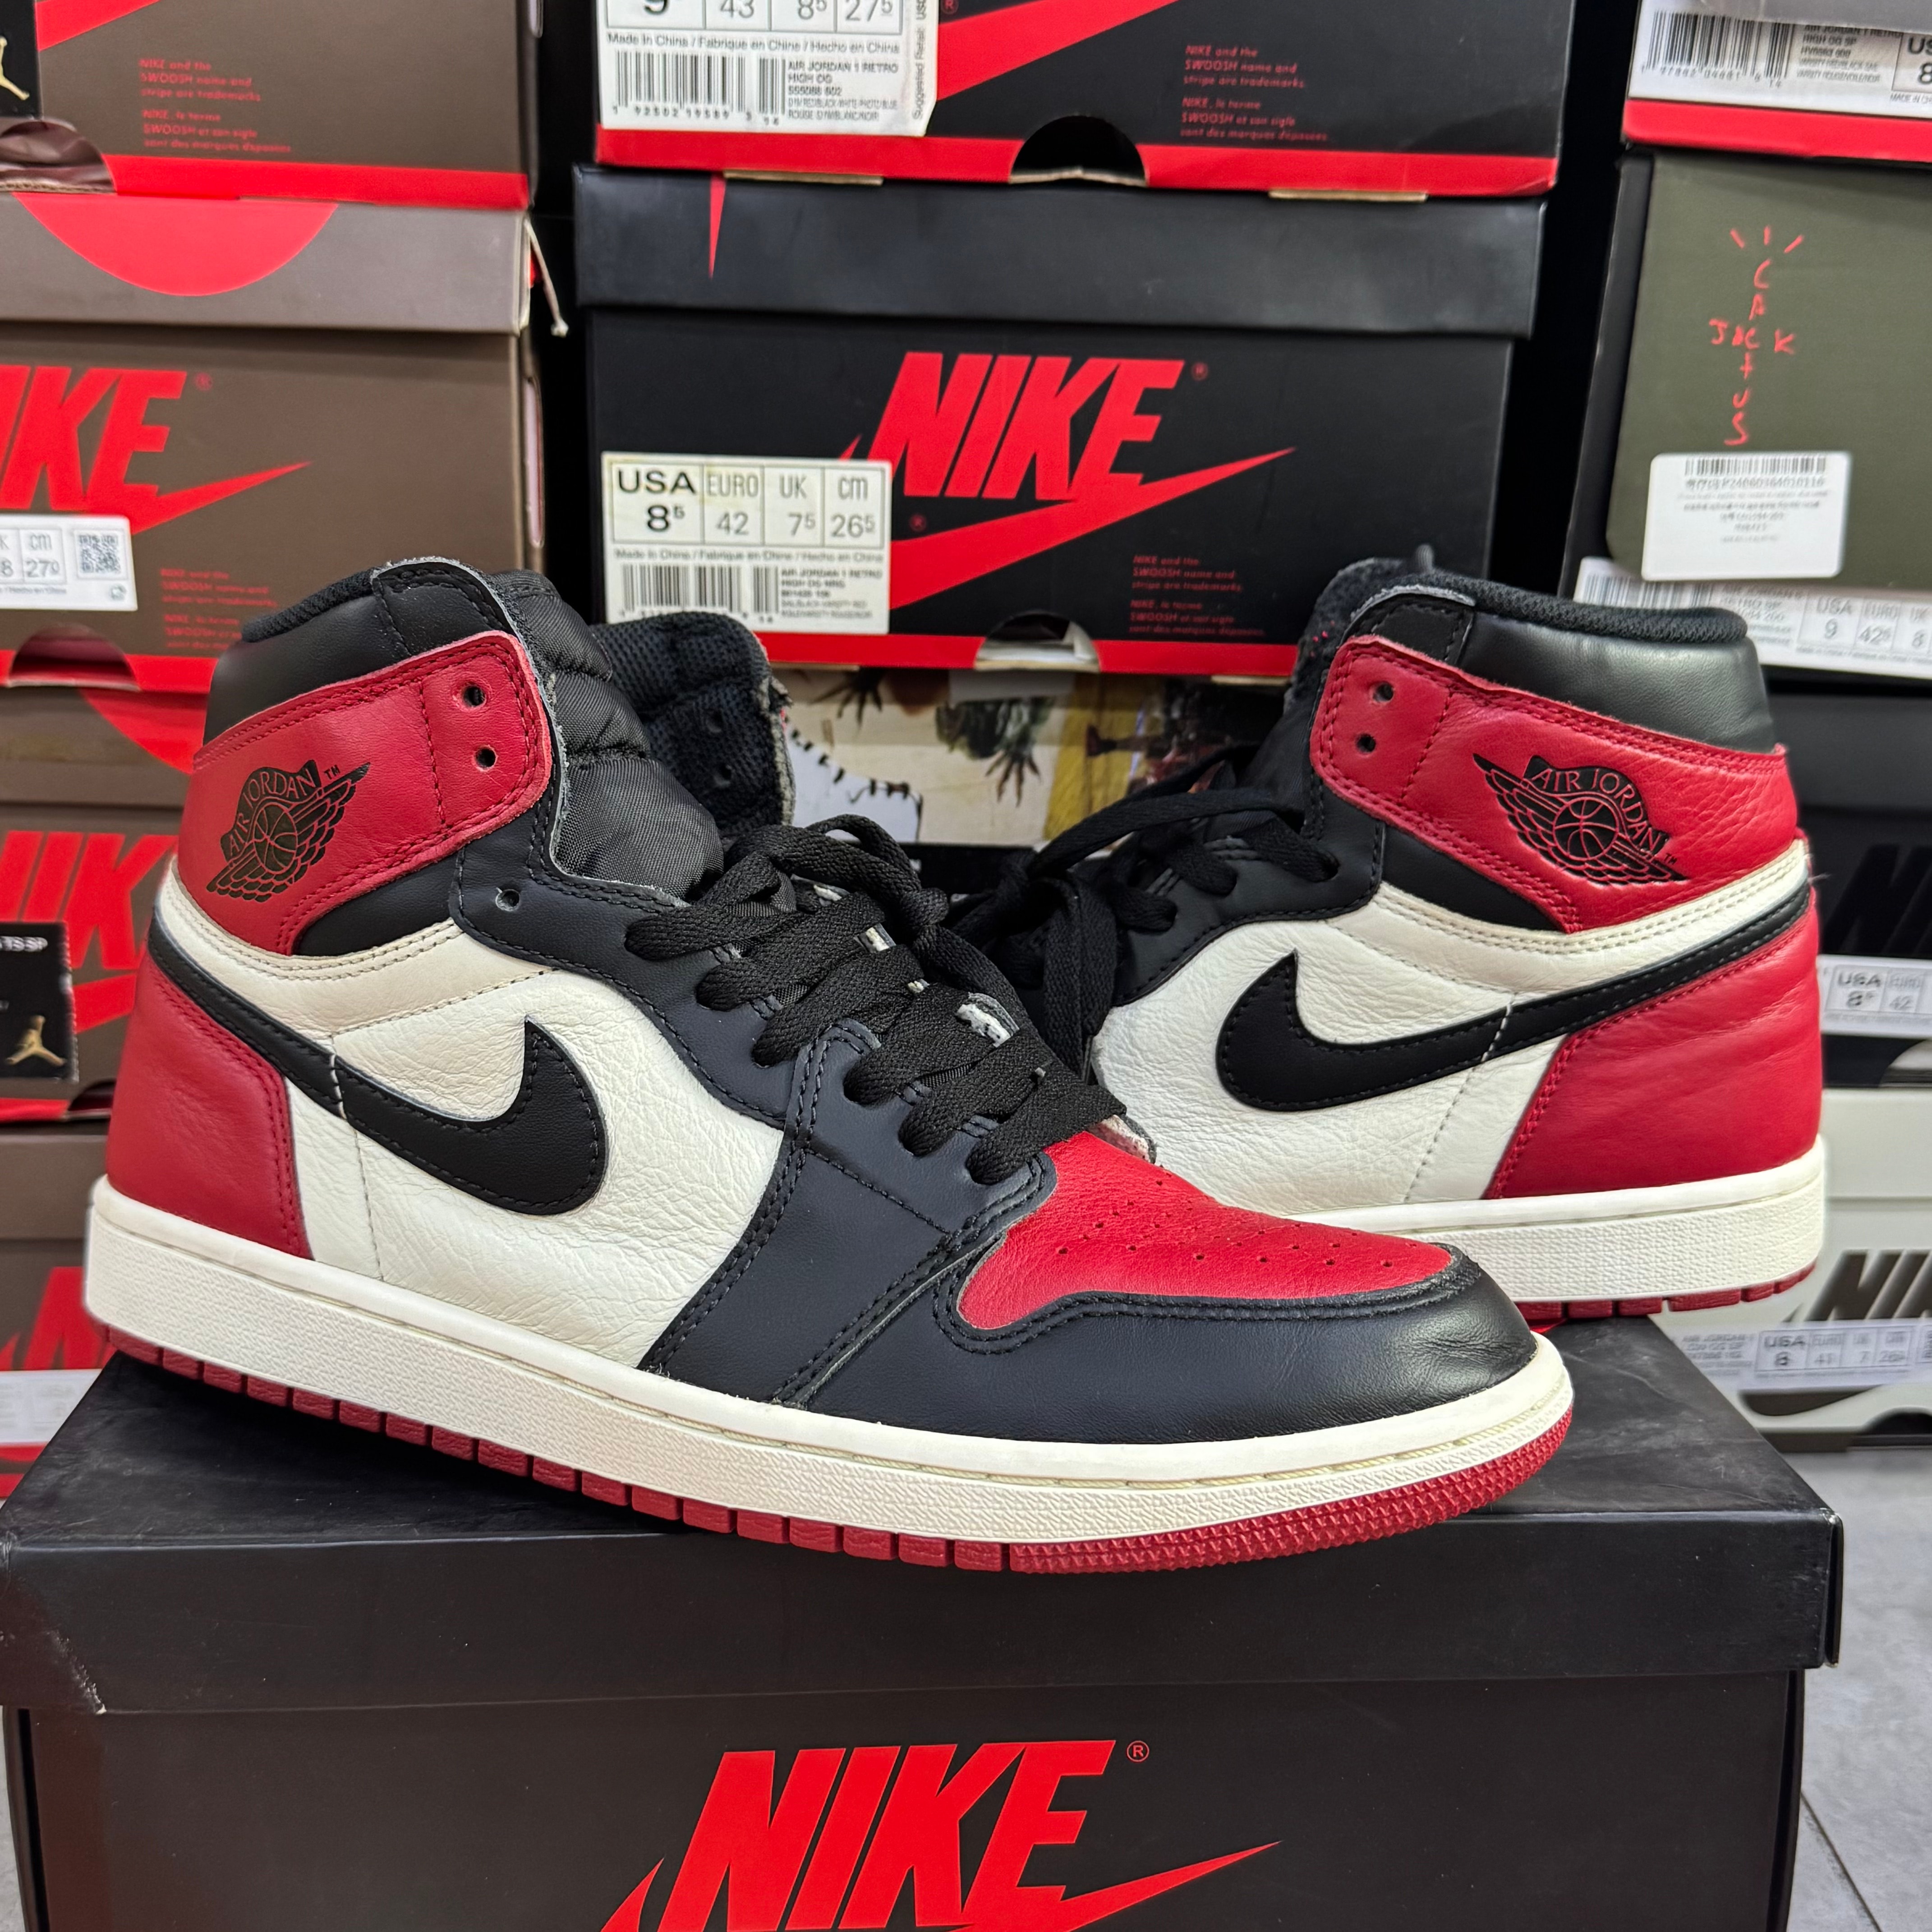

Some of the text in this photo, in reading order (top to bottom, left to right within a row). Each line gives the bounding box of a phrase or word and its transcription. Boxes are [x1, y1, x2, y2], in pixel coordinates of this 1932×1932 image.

[607, 32, 639, 45] Made
[656, 35, 689, 47] China
[788, 61, 805, 72] AIR
[808, 61, 851, 72] JORDAN
[866, 351, 1185, 501] NIKE
[618, 470, 868, 501] USA EURO UK cm
[717, 512, 749, 536] 42
[29, 532, 52, 551] cm
[1823, 618, 1840, 640] 9
[229, 812, 252, 856] AIR
[244, 768, 317, 808] JORDAN
[1531, 768, 1582, 792] AIR
[1592, 768, 1662, 852] JORDAN
[657, 1740, 1116, 1932] NIKE
